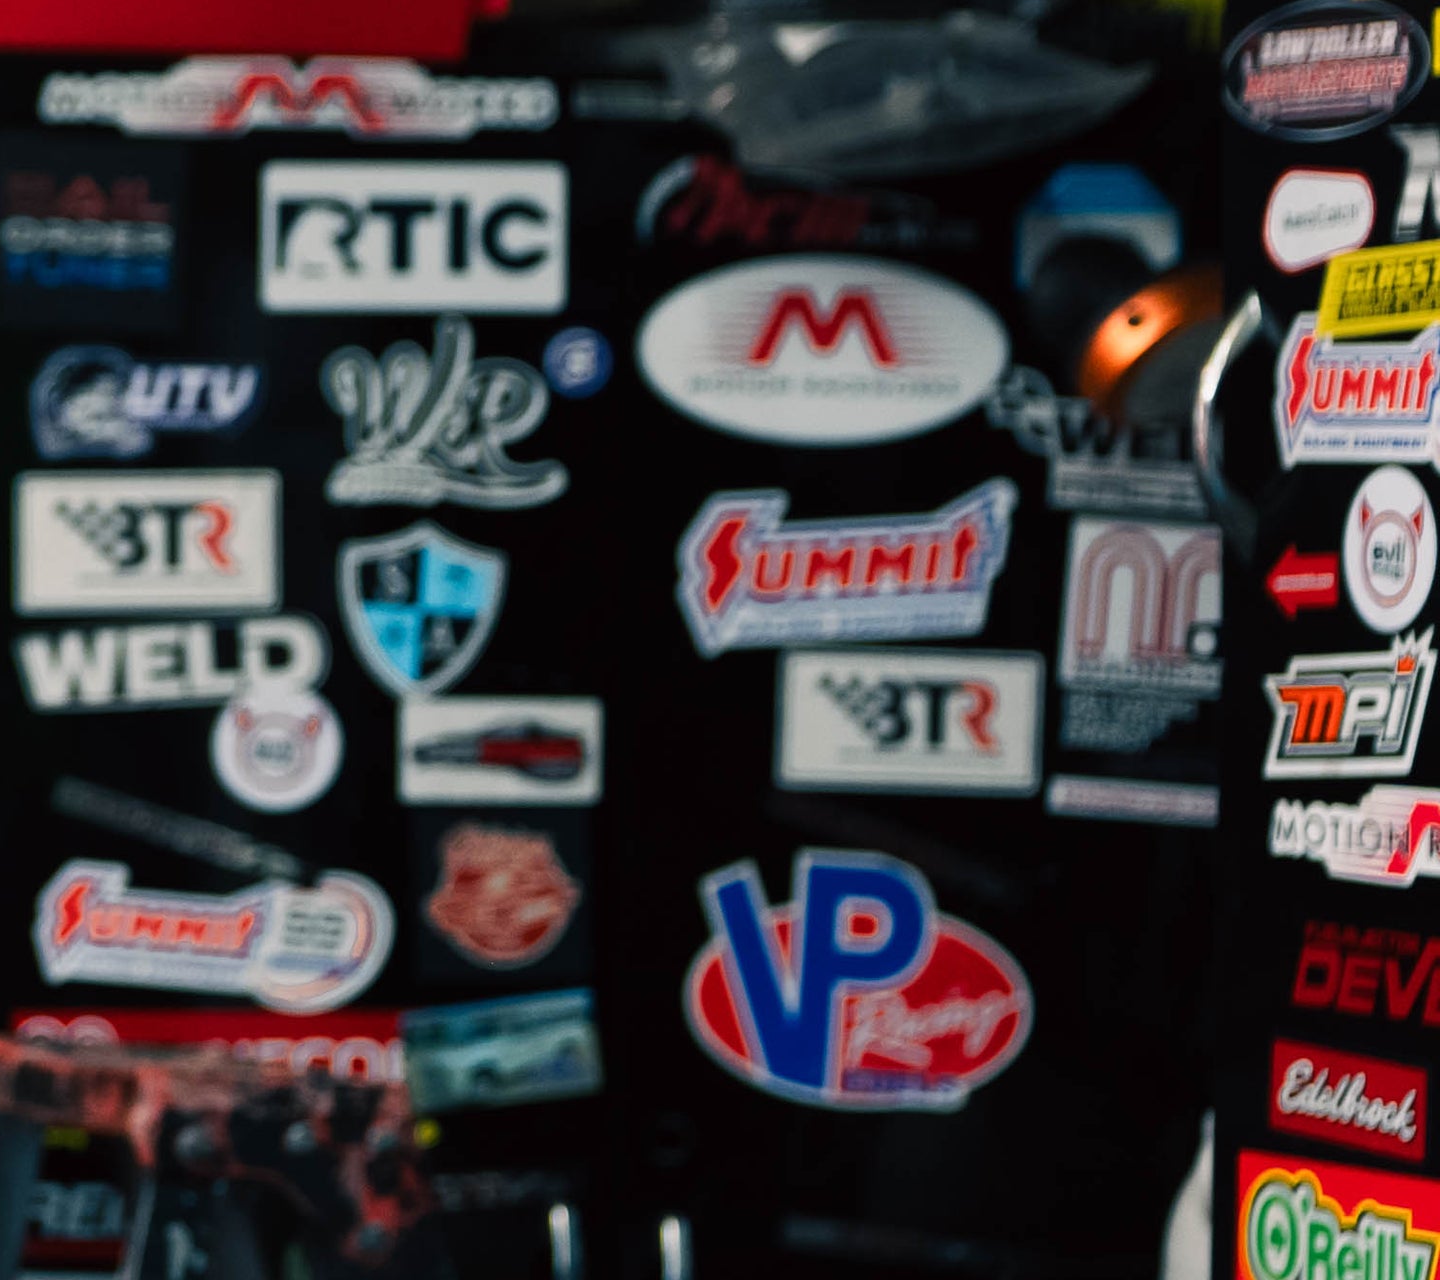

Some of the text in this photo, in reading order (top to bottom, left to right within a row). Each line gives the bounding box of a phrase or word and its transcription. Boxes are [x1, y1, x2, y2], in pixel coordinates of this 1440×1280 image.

[276, 198, 552, 278] RTIC
[1288, 330, 1436, 426] SUMMIT
[705, 508, 978, 614] SUMMIT
[1373, 538, 1406, 564] evil
[23, 622, 316, 708] WELD
[852, 680, 1001, 756] BTR
[716, 863, 926, 1091] VP
[1278, 1058, 1417, 1142] Edelbrock
